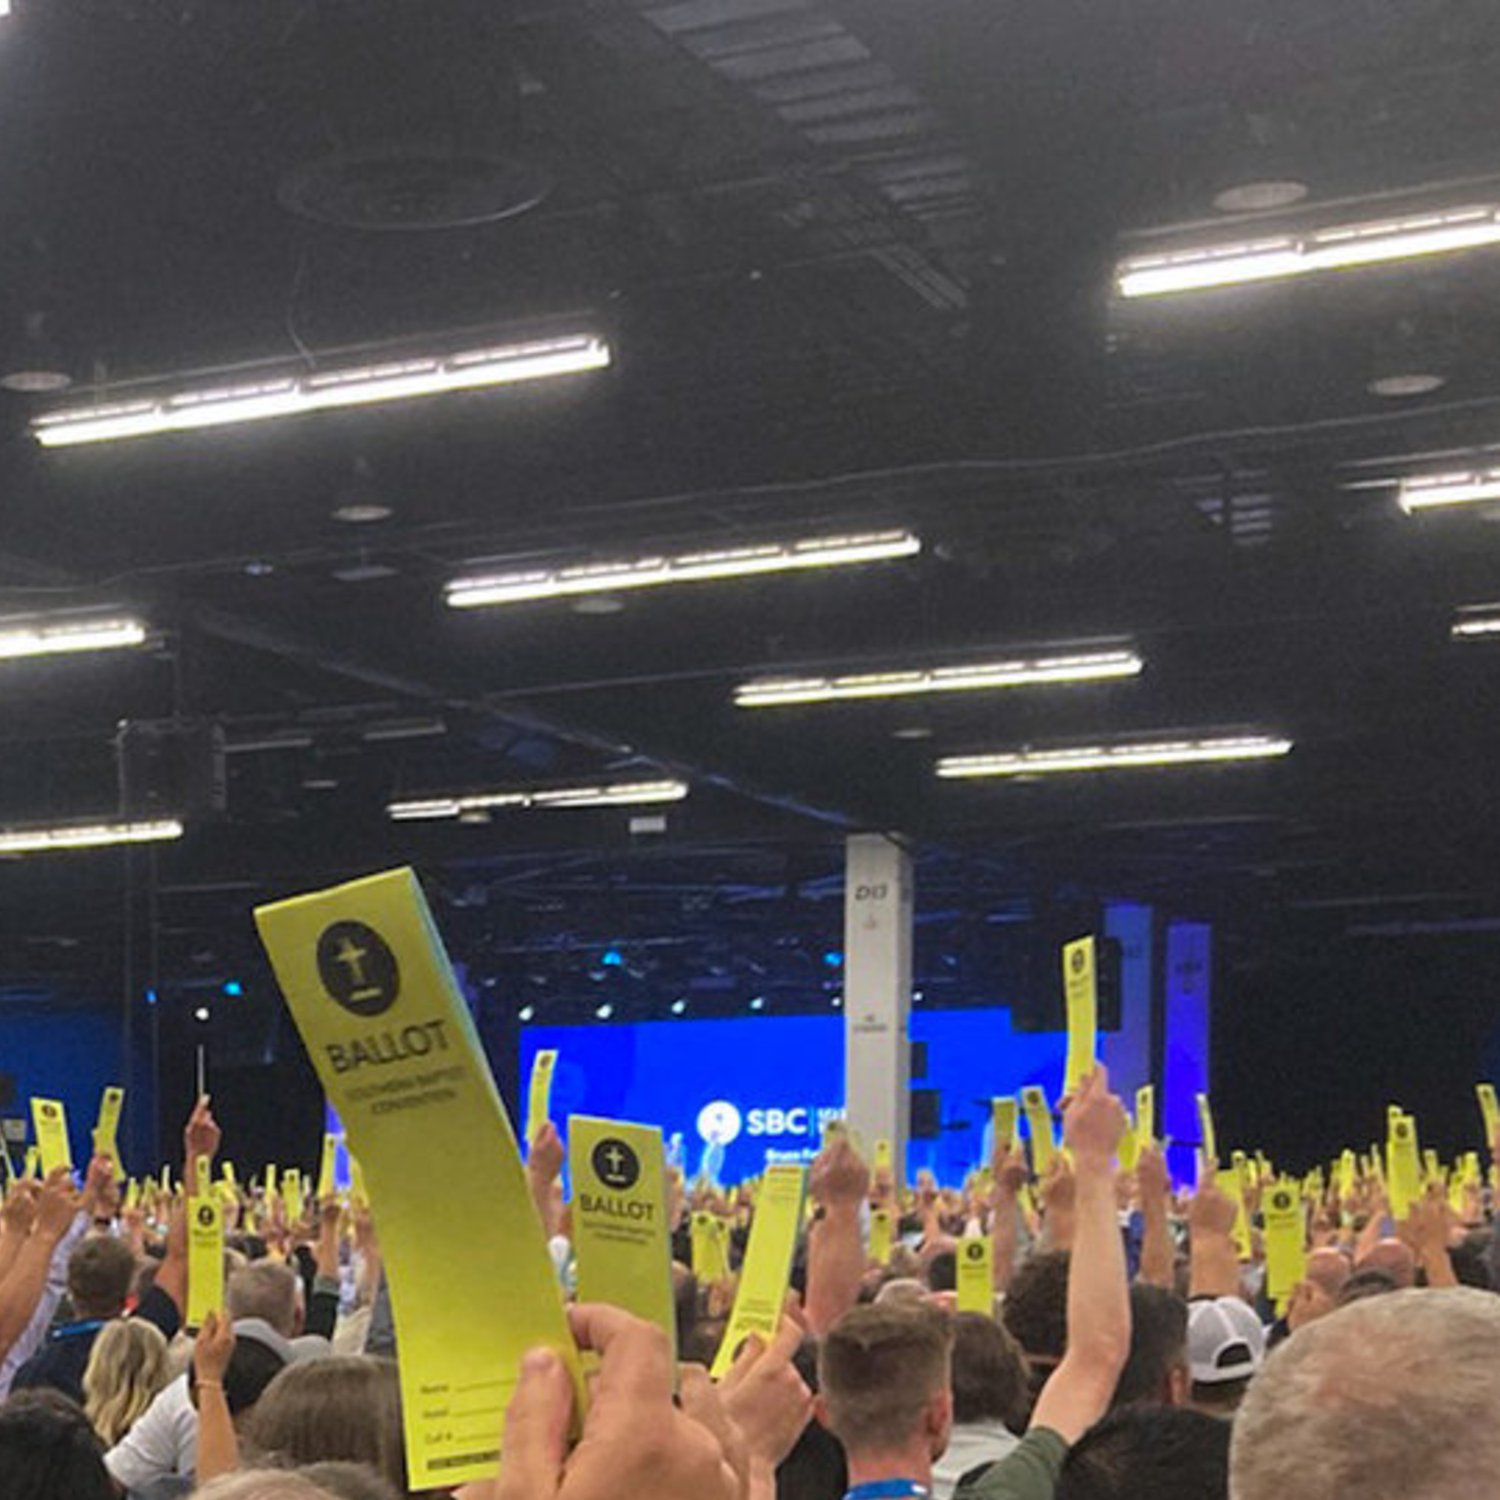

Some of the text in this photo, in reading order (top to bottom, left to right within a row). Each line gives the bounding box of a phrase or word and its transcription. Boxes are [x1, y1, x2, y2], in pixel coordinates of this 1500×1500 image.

[325, 1018, 450, 1074] BALLOT
[746, 1107, 807, 1136] SBC
[579, 1193, 655, 1221] BALLOT
